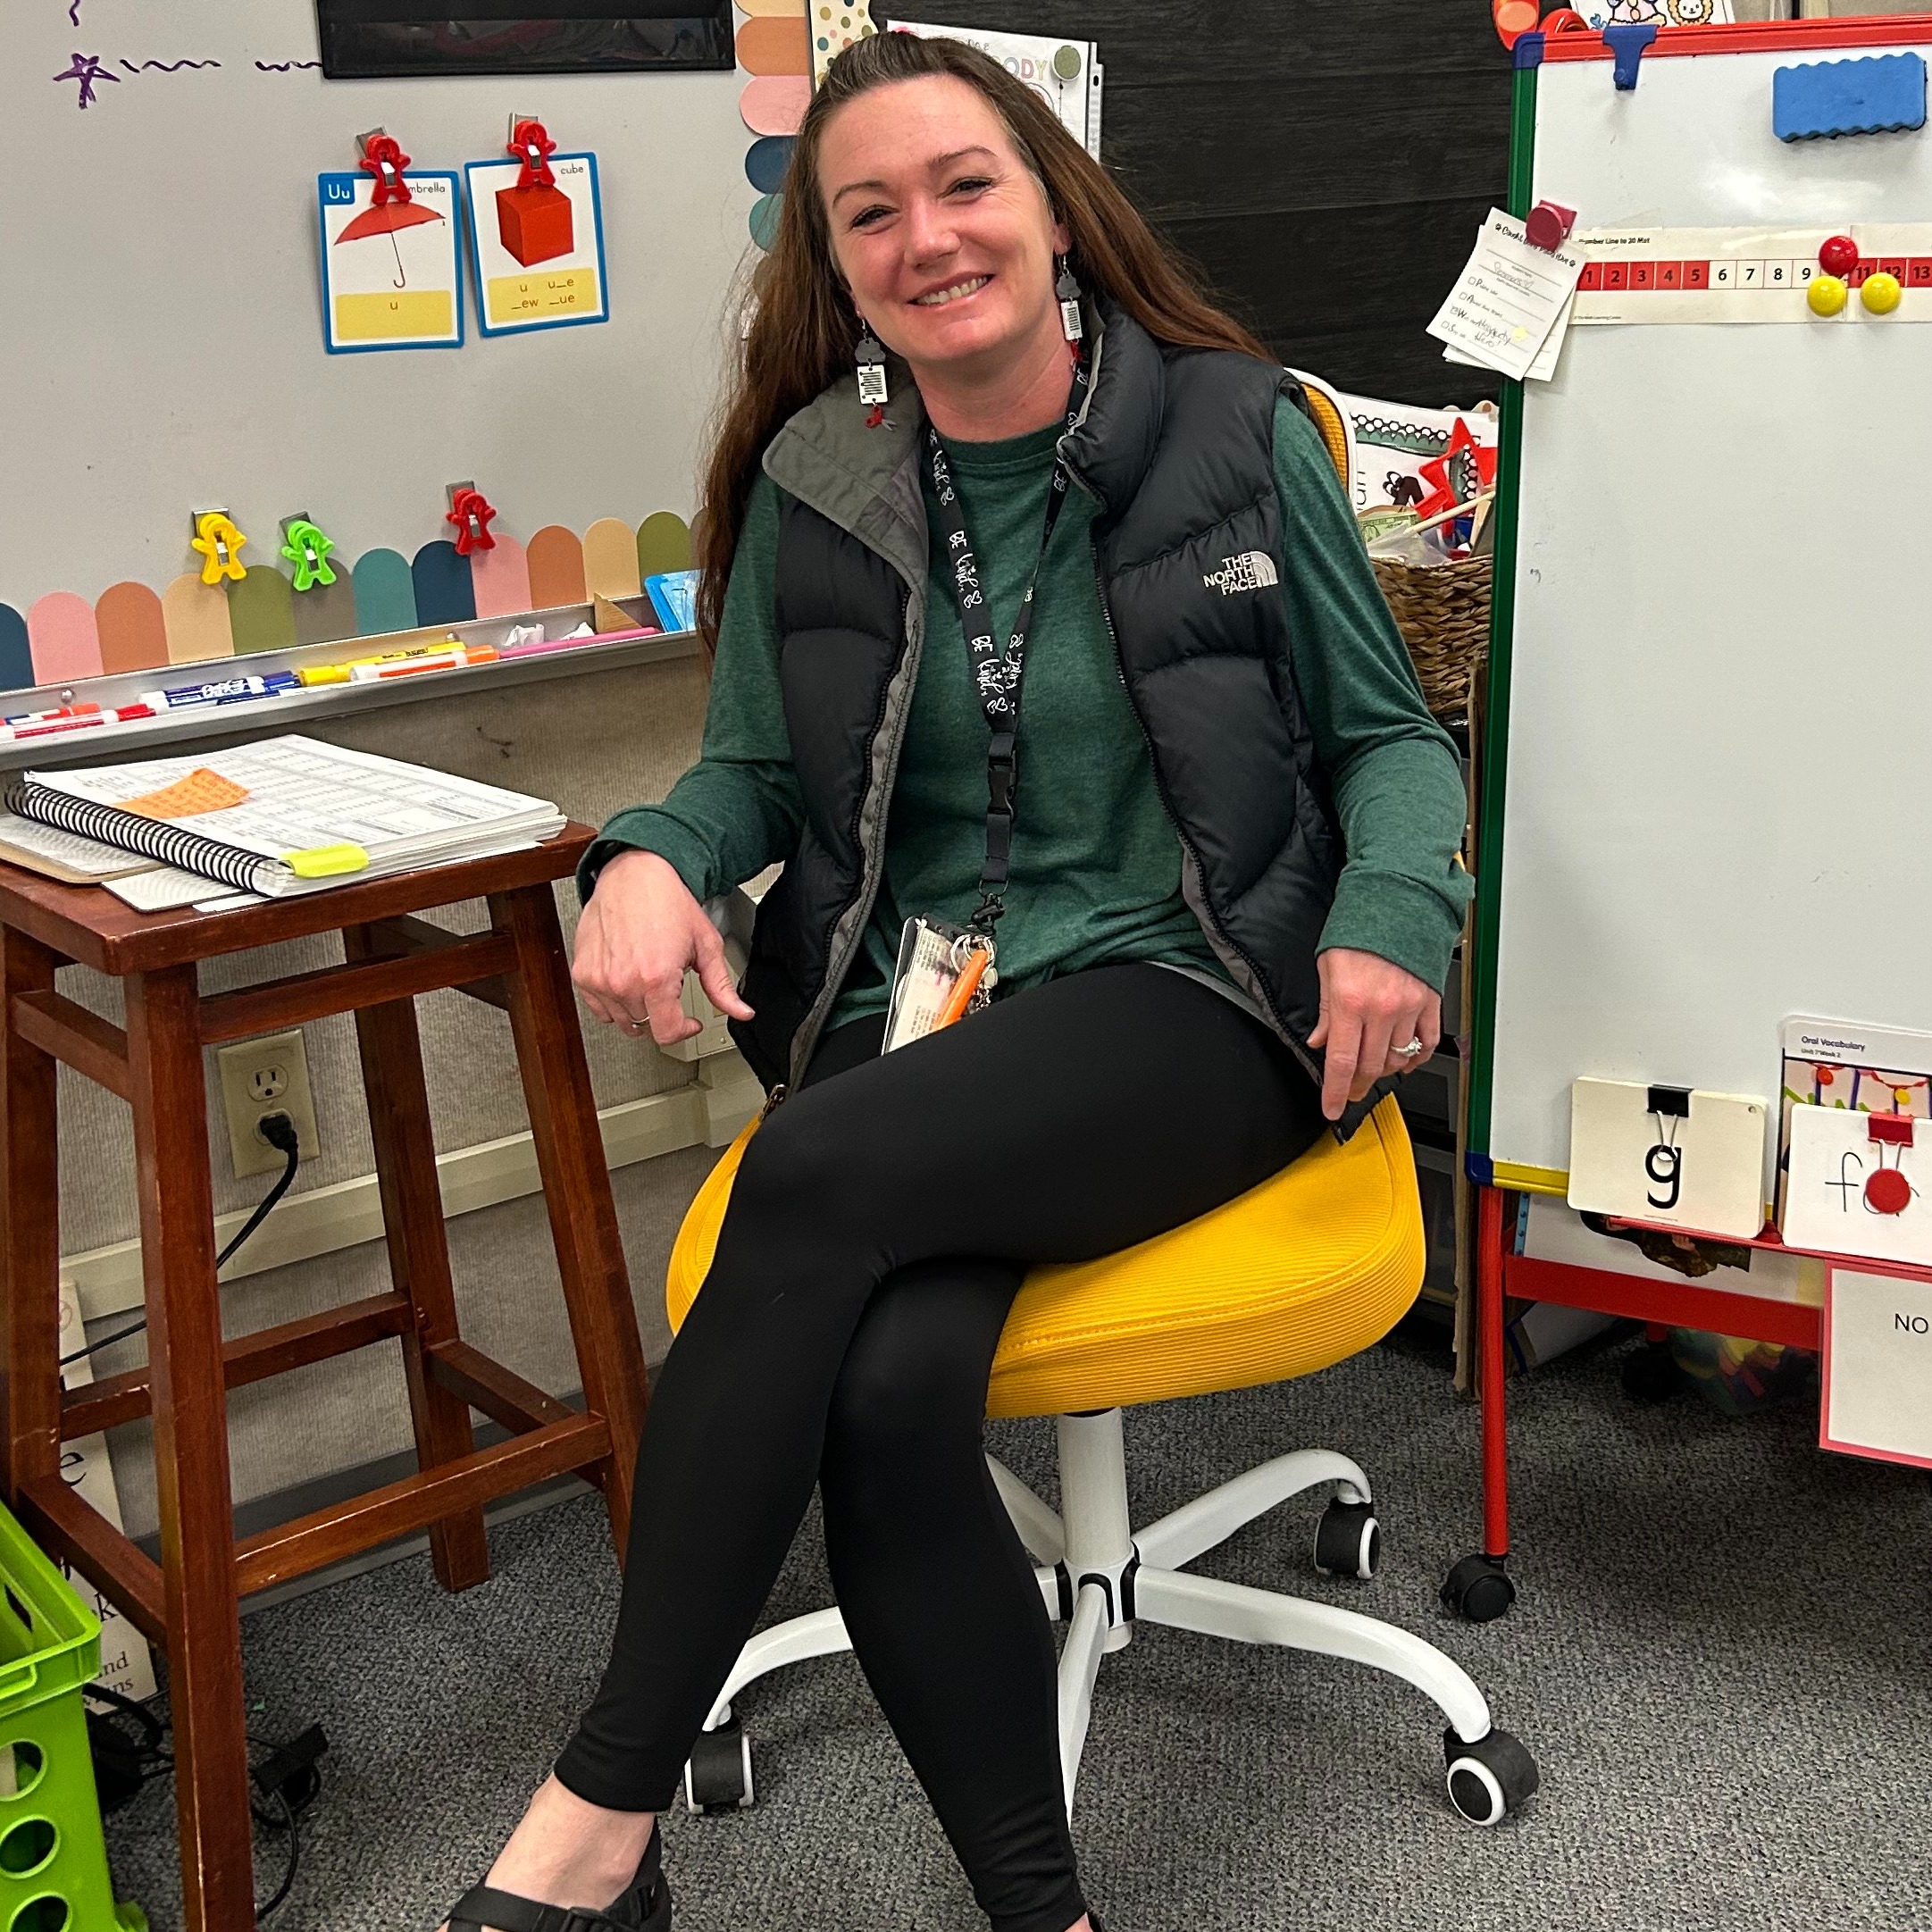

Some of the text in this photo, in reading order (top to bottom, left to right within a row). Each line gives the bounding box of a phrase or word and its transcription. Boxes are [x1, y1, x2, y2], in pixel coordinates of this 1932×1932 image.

[992, 55, 1048, 80] ODY
[560, 163, 584, 175] cube
[328, 183, 350, 200] Uu
[408, 181, 446, 194] mbrella
[1605, 237, 1618, 245] Line
[1585, 270, 1593, 283] 1
[1610, 270, 1620, 283] 2
[1637, 269, 1646, 282] 3
[1663, 269, 1673, 282] 4
[1691, 268, 1700, 282] 5
[1719, 268, 1727, 281] 6
[1746, 268, 1755, 281] 7
[1774, 267, 1783, 280] 8
[1802, 267, 1811, 280] 9
[1855, 266, 1870, 280] 11
[1913, 266, 1930, 279] 13
[519, 282, 529, 293] u
[389, 301, 399, 312] u
[949, 531, 967, 549] BE
[1221, 553, 1252, 569] THE
[1203, 565, 1255, 588] NORTH
[1221, 576, 1257, 596] FACE
[971, 635, 993, 652] BE
[1801, 1035, 1865, 1052] Oral Vocabulary
[1644, 1144, 1683, 1209] g
